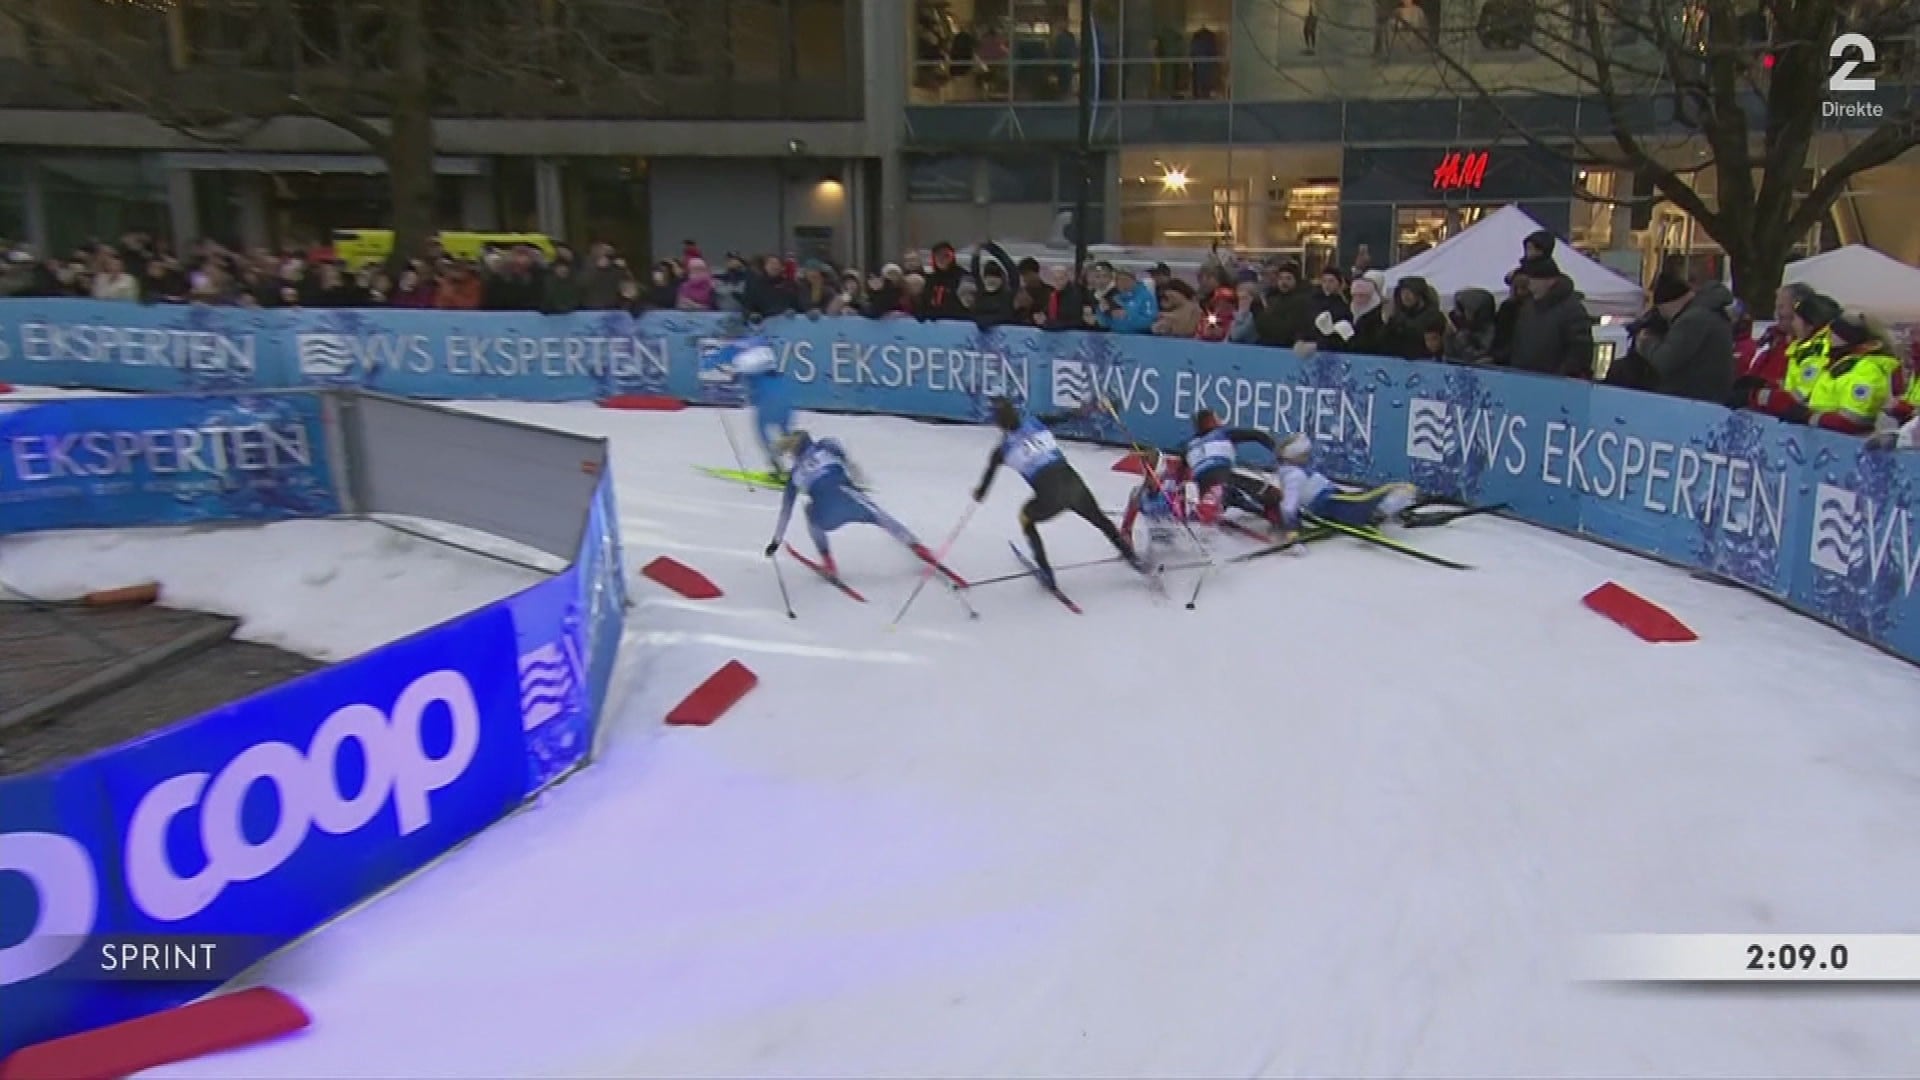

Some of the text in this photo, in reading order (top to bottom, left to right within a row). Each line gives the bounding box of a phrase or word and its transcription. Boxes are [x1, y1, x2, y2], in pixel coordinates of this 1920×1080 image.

[20, 322, 256, 371] EKSPERTEN
[351, 334, 671, 378] VVS EKSPERTEN
[831, 341, 1029, 402] EKSPERTEN
[1090, 363, 1375, 448] VVS EKSPERTEN
[11, 422, 312, 482] EKSPERTEN
[1455, 404, 1789, 546] VVS EKSPERTEN
[1862, 496, 1920, 598] VV
[125, 670, 481, 921] coop
